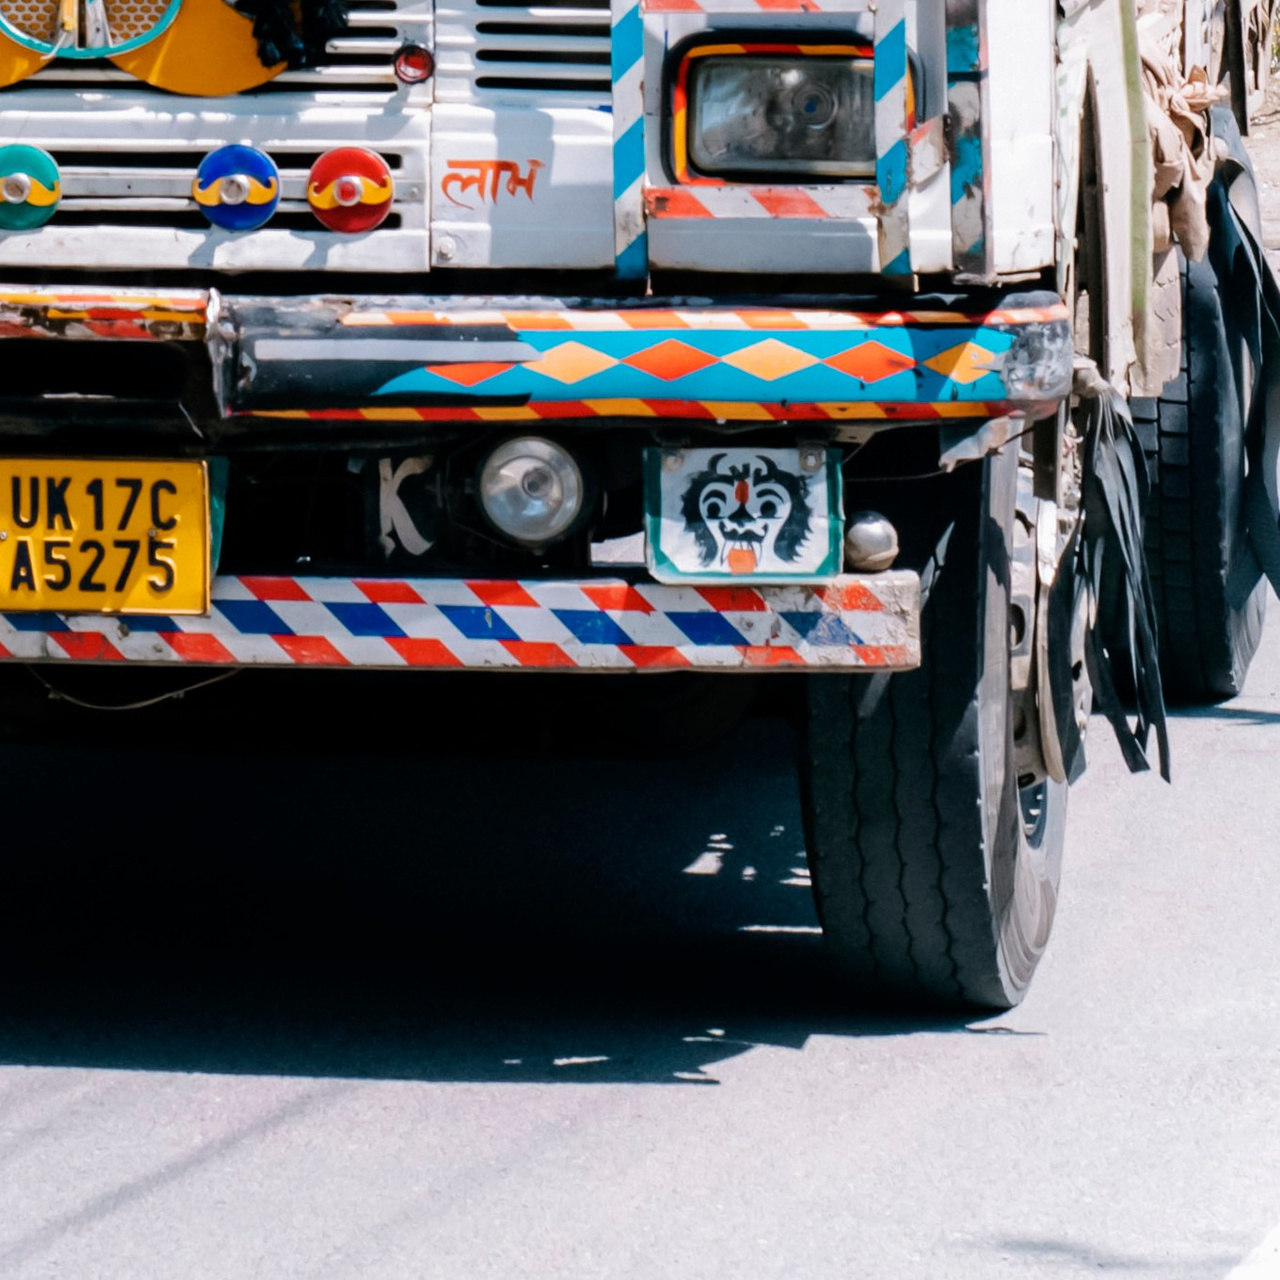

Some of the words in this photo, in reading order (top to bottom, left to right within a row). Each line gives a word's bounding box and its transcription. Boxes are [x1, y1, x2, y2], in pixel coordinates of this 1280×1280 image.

[441, 157, 546, 210] लाभ
[11, 476, 178, 531] UK17C
[10, 537, 177, 596] A5275
